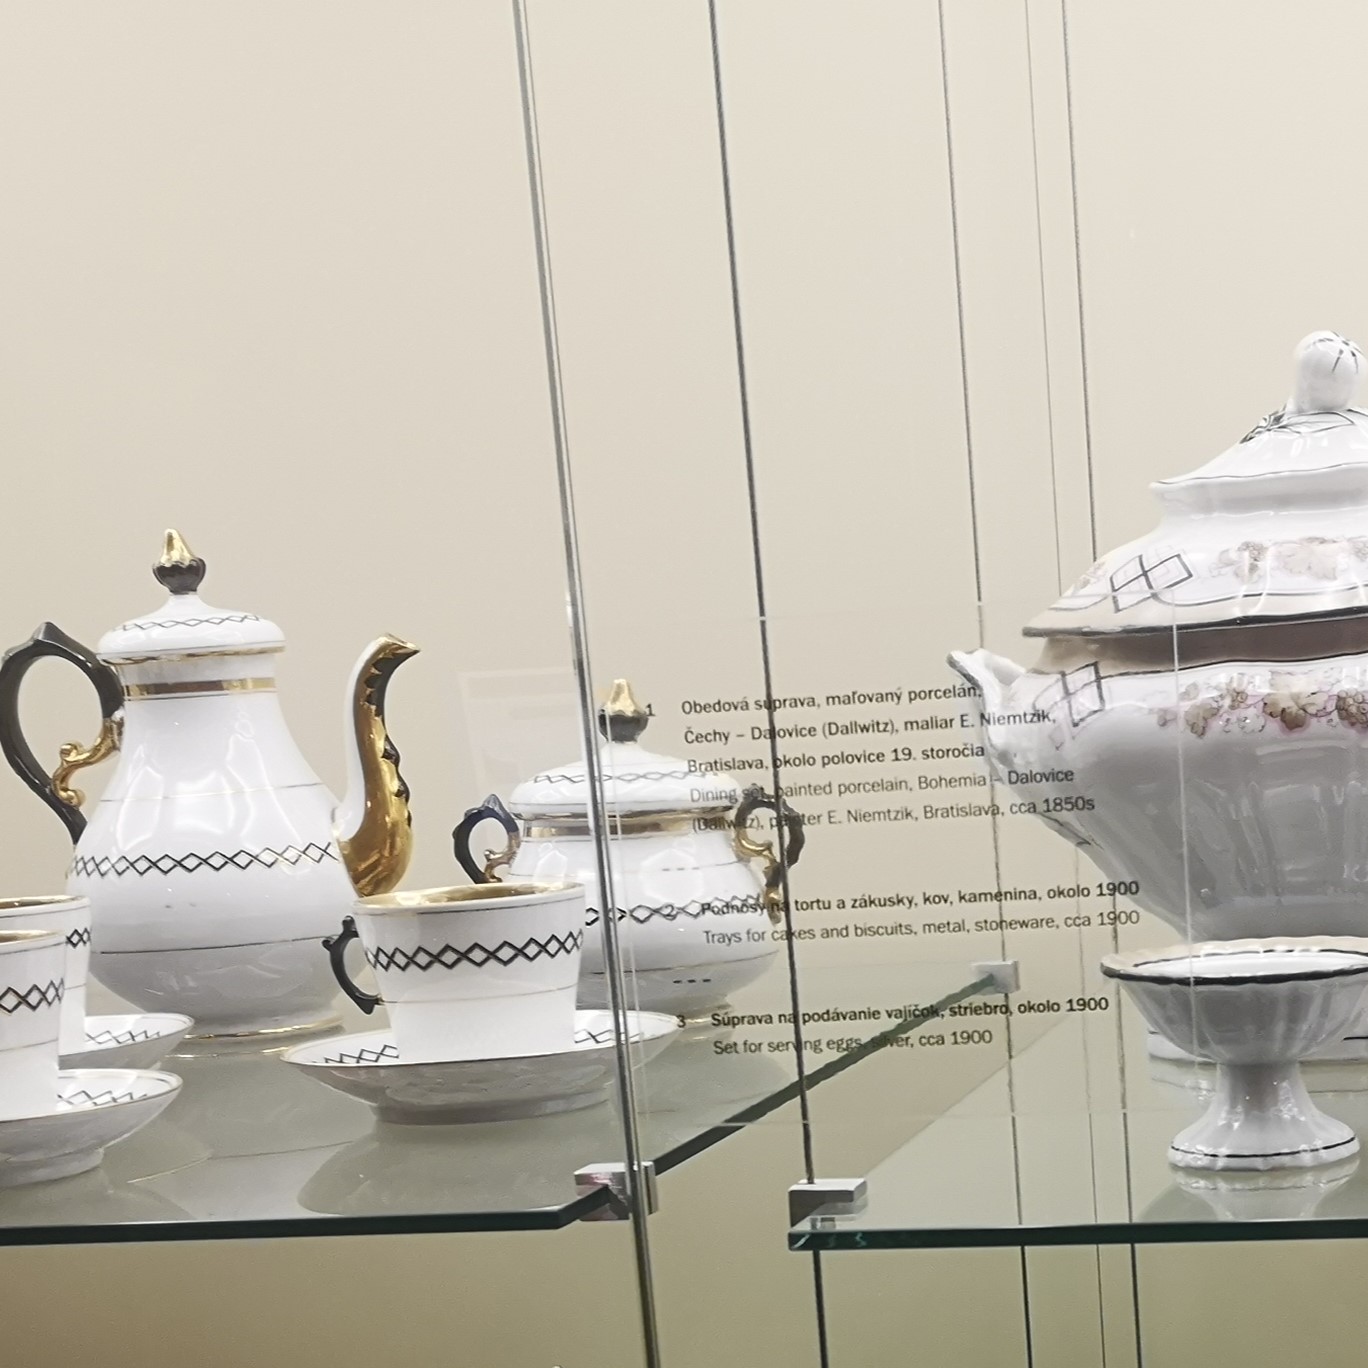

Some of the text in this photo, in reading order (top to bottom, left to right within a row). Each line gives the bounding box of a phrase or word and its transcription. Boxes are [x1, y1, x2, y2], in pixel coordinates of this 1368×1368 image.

[645, 703, 656, 717] 1
[681, 697, 749, 715] Obedová
[826, 687, 904, 706] maľovaný
[684, 726, 730, 746] Čechy
[822, 719, 899, 739] (Dallwitz),
[904, 715, 955, 732] maliar
[961, 714, 975, 729] E.
[687, 742, 985, 773] Bratislava, okolo polovice 19. storočia
[837, 776, 913, 798] porcelain,
[918, 774, 987, 791] Bohemia
[1008, 767, 1075, 785] Dalovice
[828, 810, 842, 824] E.
[847, 804, 918, 822] Niemtzik,
[924, 801, 1004, 820] Bratislava,
[1010, 800, 1036, 815] cca
[1043, 796, 1095, 813] 1850s
[794, 897, 831, 912] tortu
[836, 898, 846, 910] a
[850, 893, 918, 910] zákusky,
[922, 891, 953, 907] kov,
[958, 887, 1042, 903] kamenina,
[1047, 883, 1091, 899] okolo
[1096, 880, 1140, 897] 1900
[703, 928, 742, 947] Trays
[747, 926, 767, 942] for
[820, 923, 850, 940] and
[854, 921, 918, 938] biscuits,
[922, 918, 970, 935] metal,
[974, 915, 1060, 932] stoneware,
[1064, 914, 1092, 928] cca
[1097, 910, 1140, 926] 1900
[676, 1014, 686, 1028] 3
[711, 1010, 773, 1029] Súprava
[802, 1006, 881, 1025] podávanie
[948, 1001, 1013, 1018] striebro,
[1018, 999, 1061, 1014] okolo
[1066, 997, 1109, 1013] 1900
[713, 1040, 740, 1055] Set
[743, 1039, 763, 1053] for
[768, 1037, 822, 1055] servng
[918, 1032, 945, 1047] cca
[950, 1029, 993, 1046] 1900
